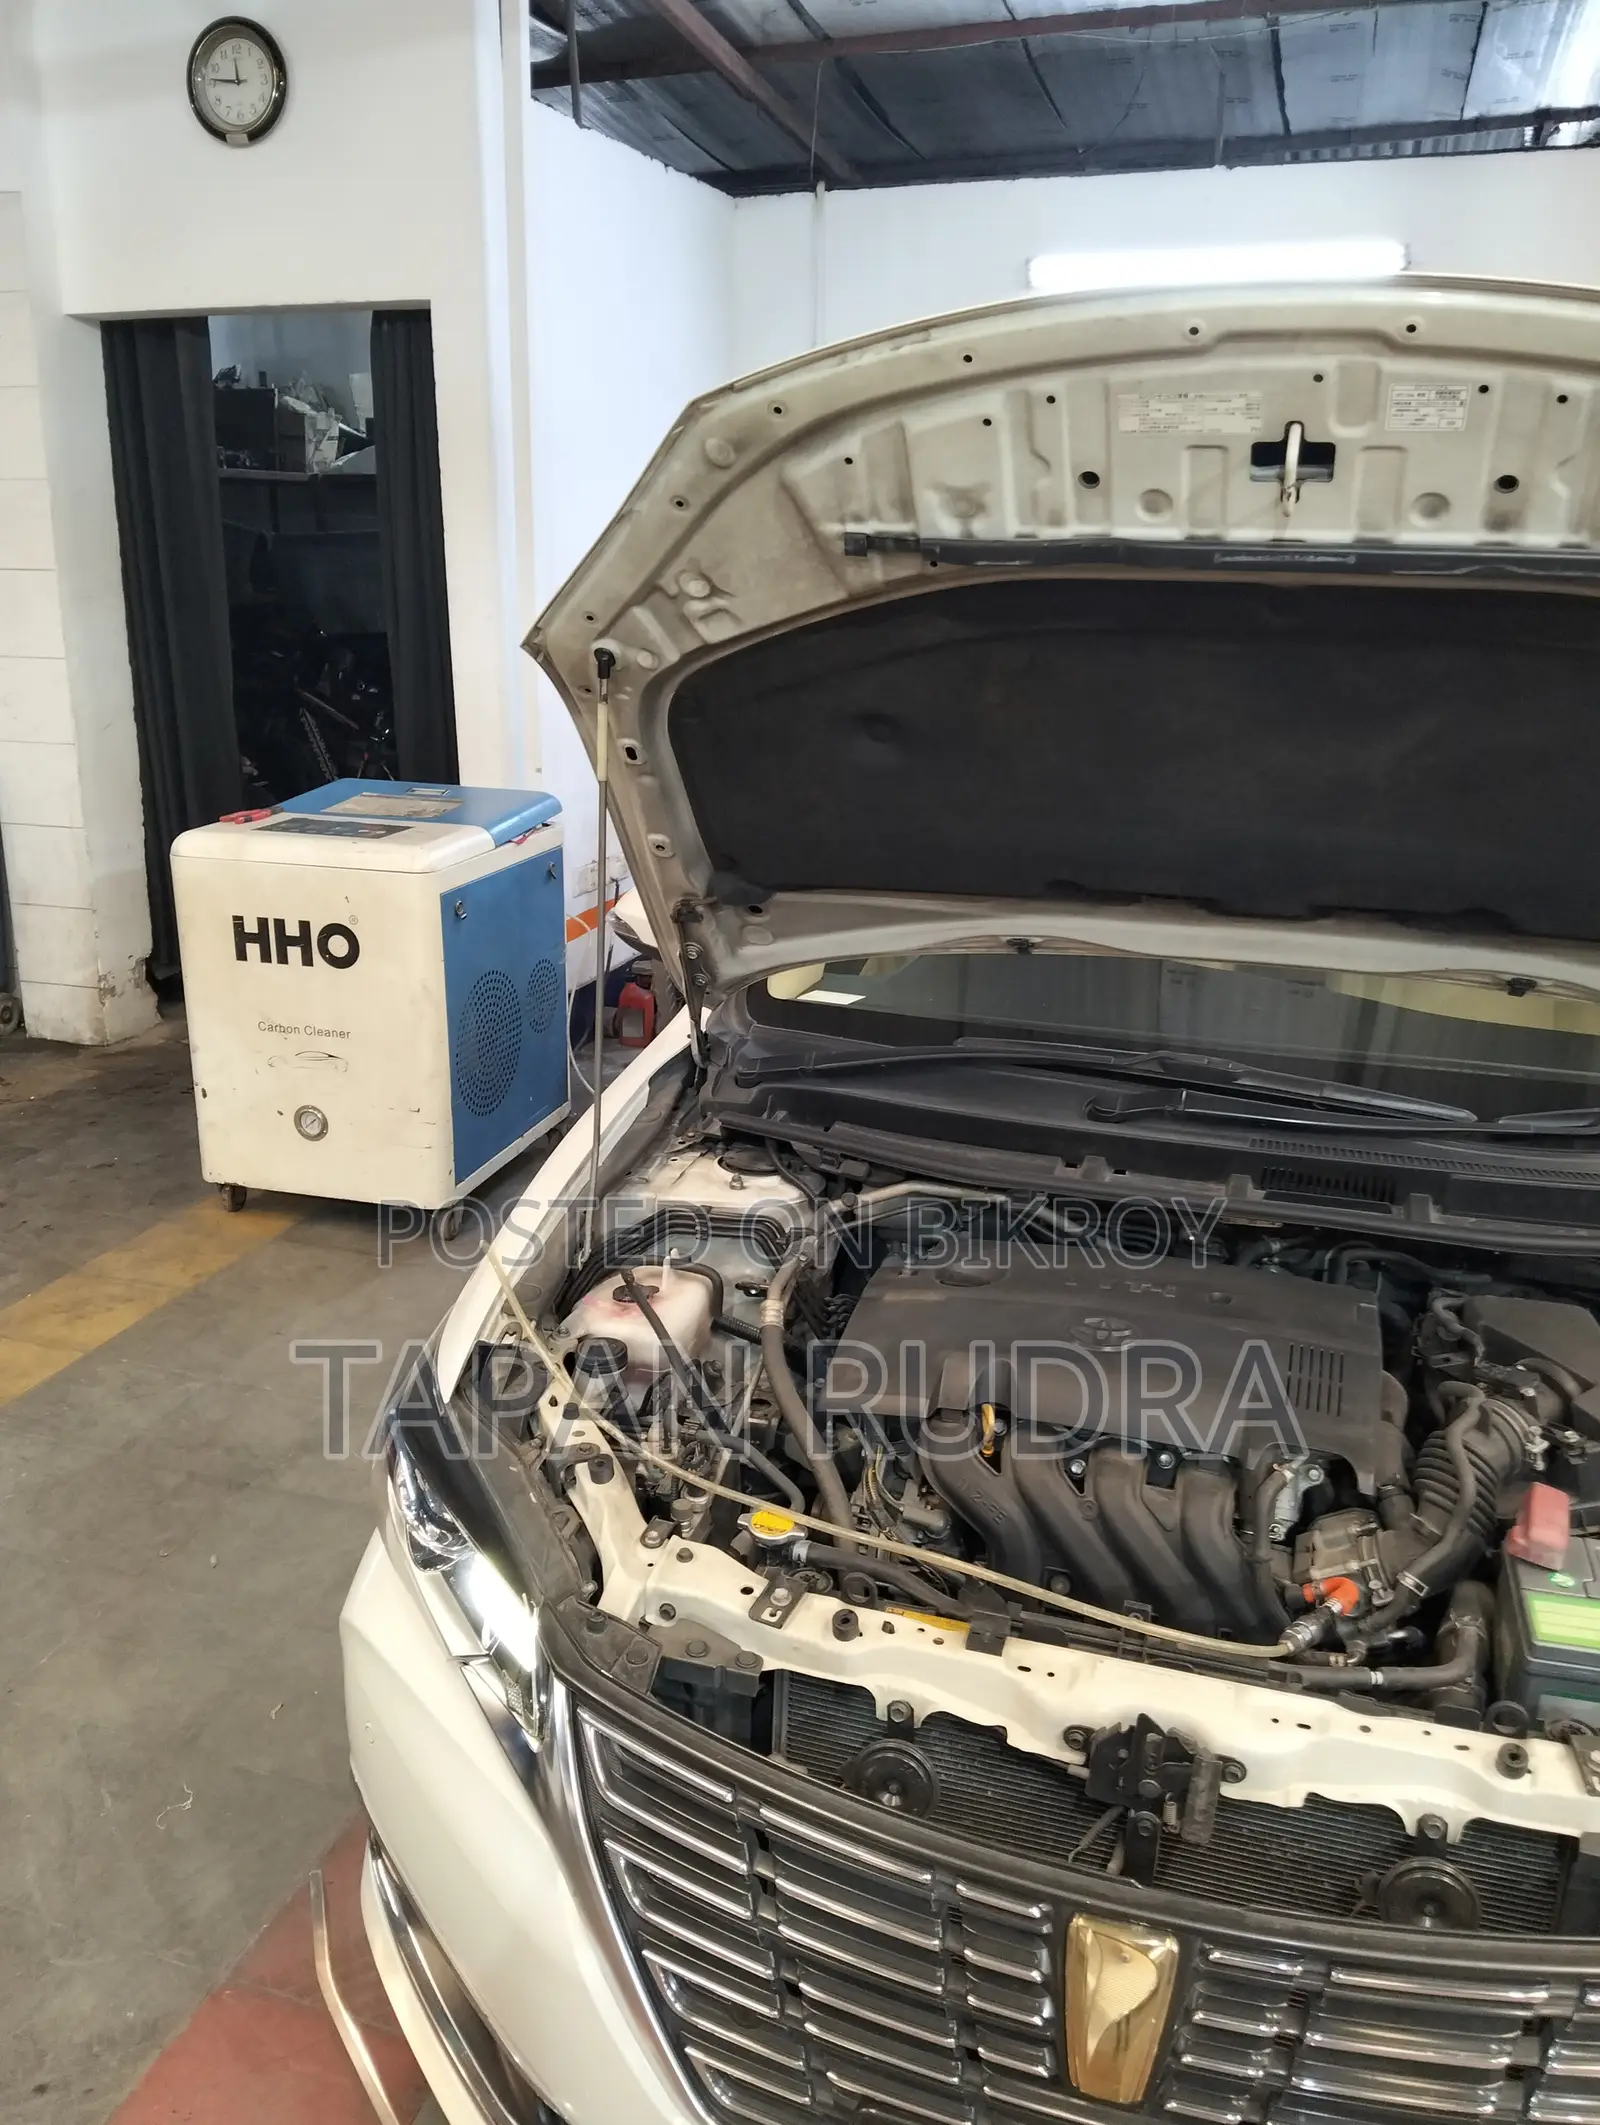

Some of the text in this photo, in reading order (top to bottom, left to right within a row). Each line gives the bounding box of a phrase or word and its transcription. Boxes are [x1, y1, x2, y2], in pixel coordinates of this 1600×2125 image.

[220, 50, 228, 60] 11
[232, 44, 241, 55] 12
[232, 915, 360, 969] HHO
[257, 1020, 351, 1039] Carbon Cleaner
